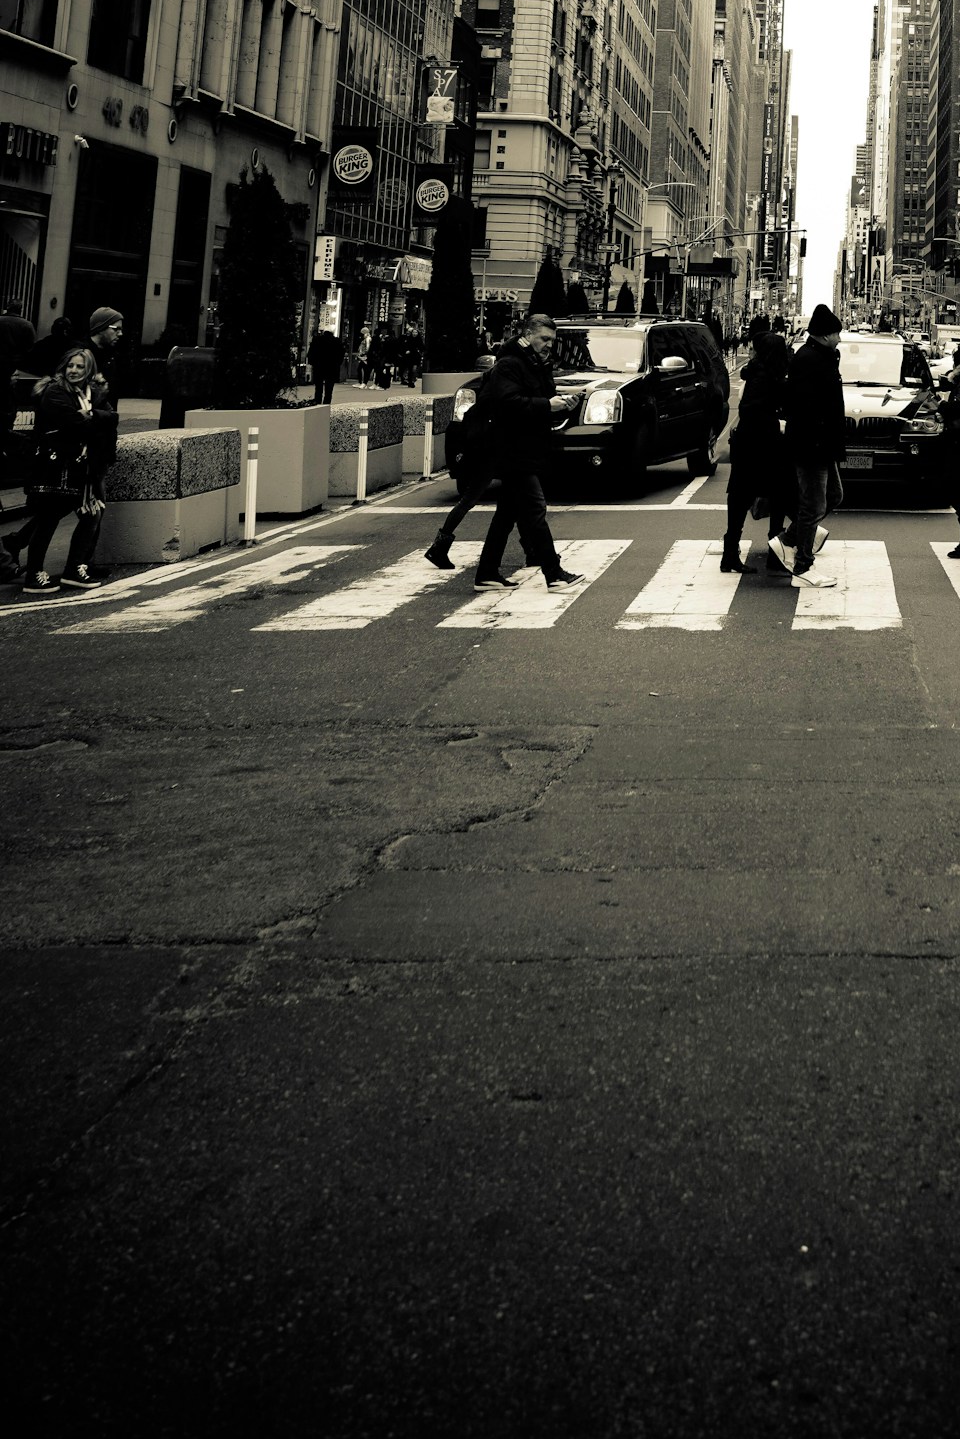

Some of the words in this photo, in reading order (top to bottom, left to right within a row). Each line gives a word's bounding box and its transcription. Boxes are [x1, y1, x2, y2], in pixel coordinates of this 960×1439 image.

[440, 70, 457, 97] 7
[338, 153, 368, 164] BURGER
[339, 159, 368, 174] KING
[420, 186, 445, 196] BURGER
[421, 191, 445, 203] KING
[324, 238, 334, 279] PERFUMES
[473, 287, 518, 302] IFTS
[13, 411, 35, 425] am
